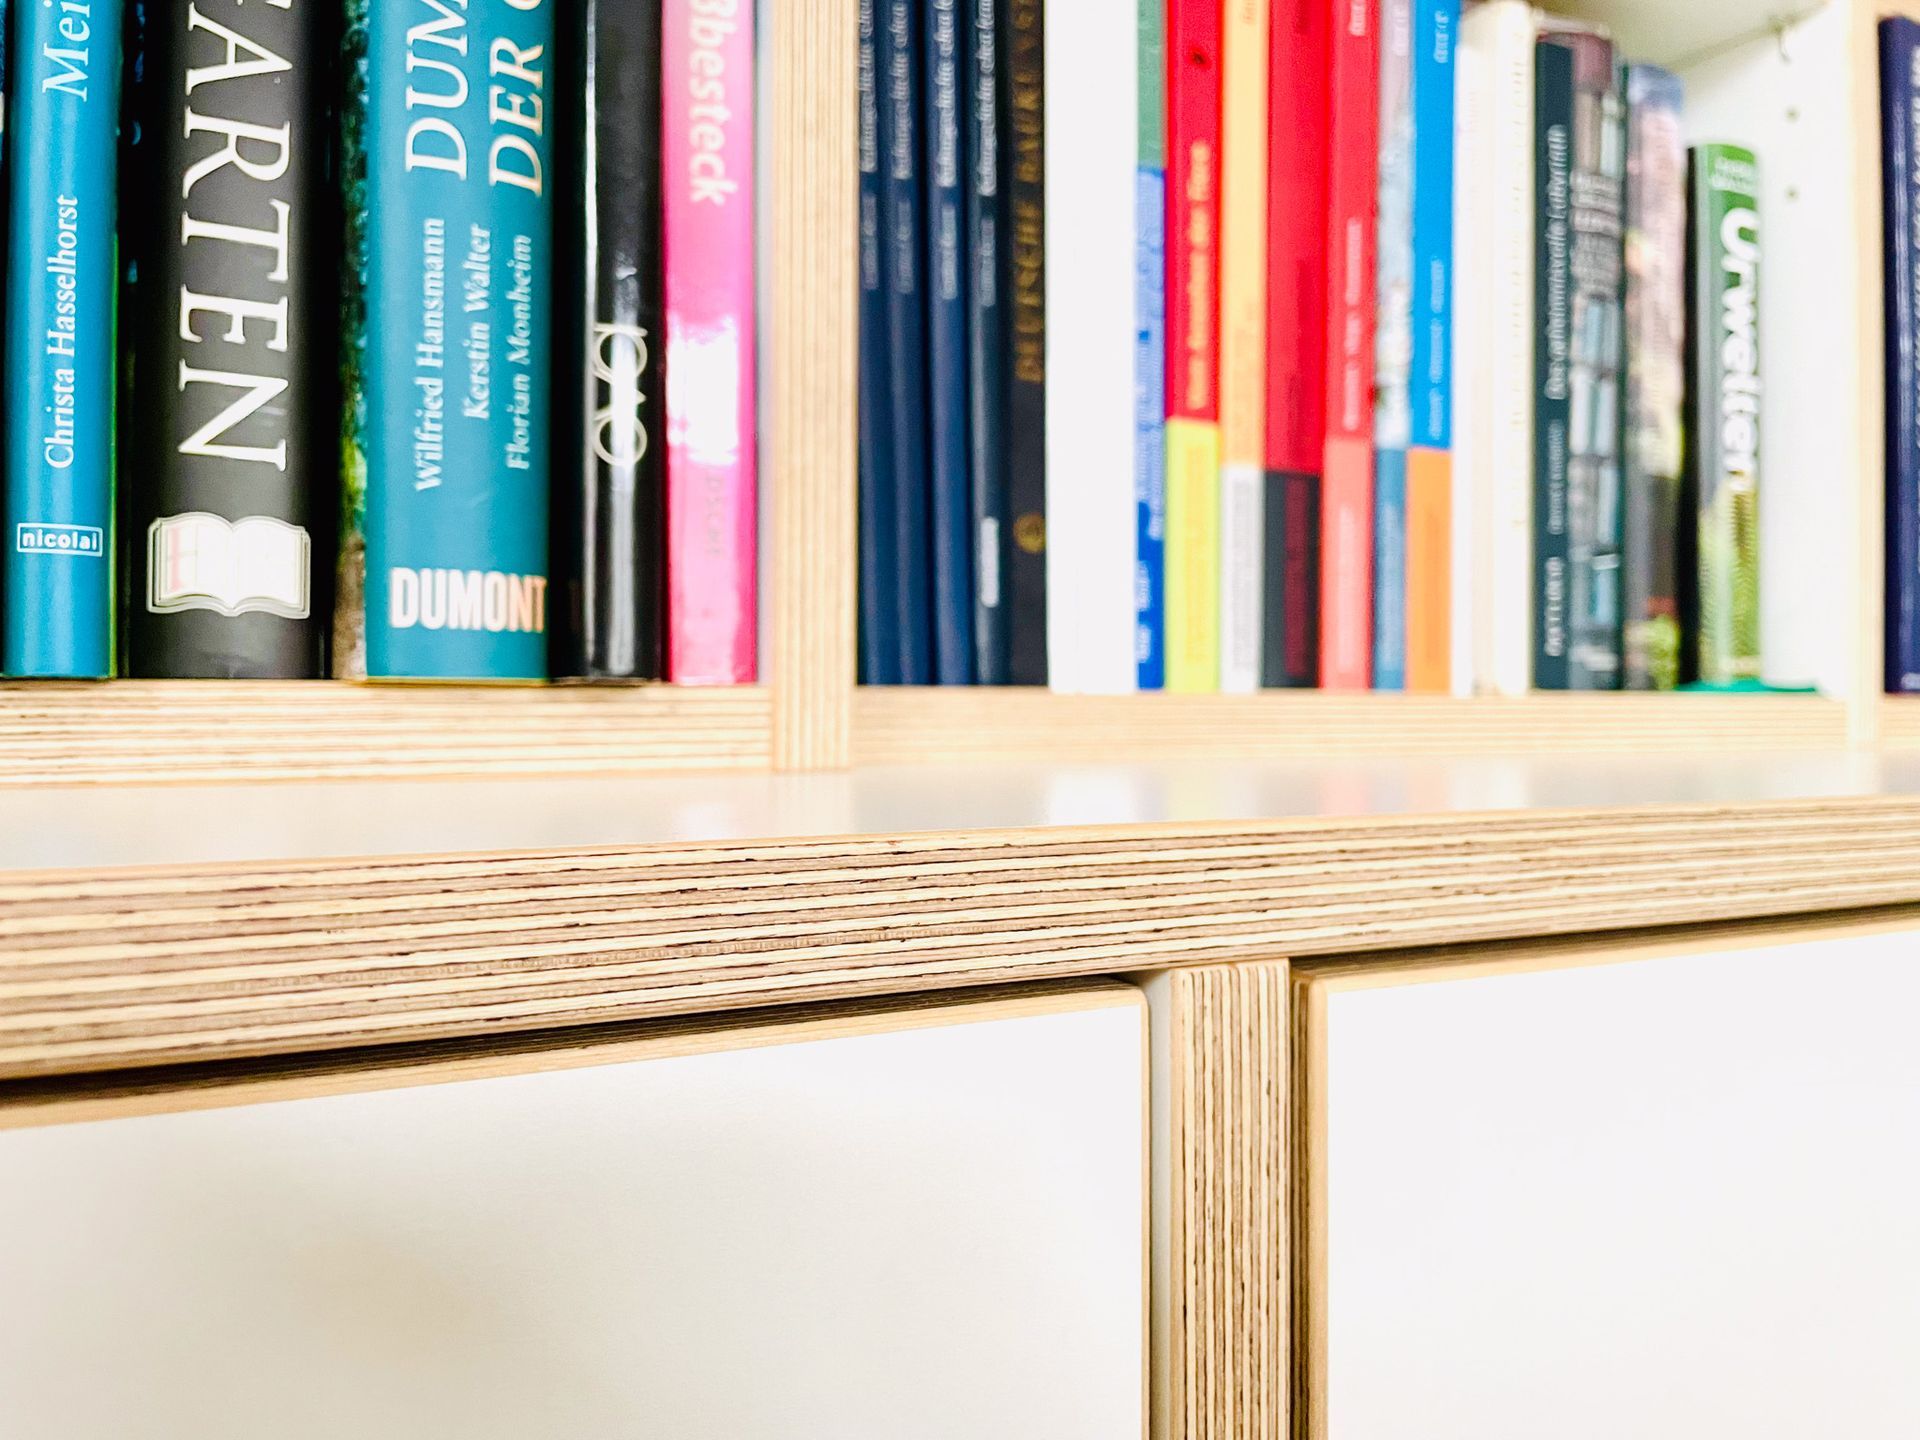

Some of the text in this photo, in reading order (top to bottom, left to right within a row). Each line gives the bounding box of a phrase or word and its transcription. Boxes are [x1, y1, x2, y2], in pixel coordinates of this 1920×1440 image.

[489, 37, 543, 197] DER
[45, 195, 79, 468] Christa Hasselhorst
[178, 0, 293, 471] ARTEN
[463, 223, 492, 421] Kerstin Walter
[507, 235, 532, 470] Florian Monheim
[1721, 207, 1761, 490] Urwelten
[414, 218, 445, 491] Wilfried Hansmann
[22, 529, 97, 552] nicolai
[389, 567, 547, 633] DUMONT
